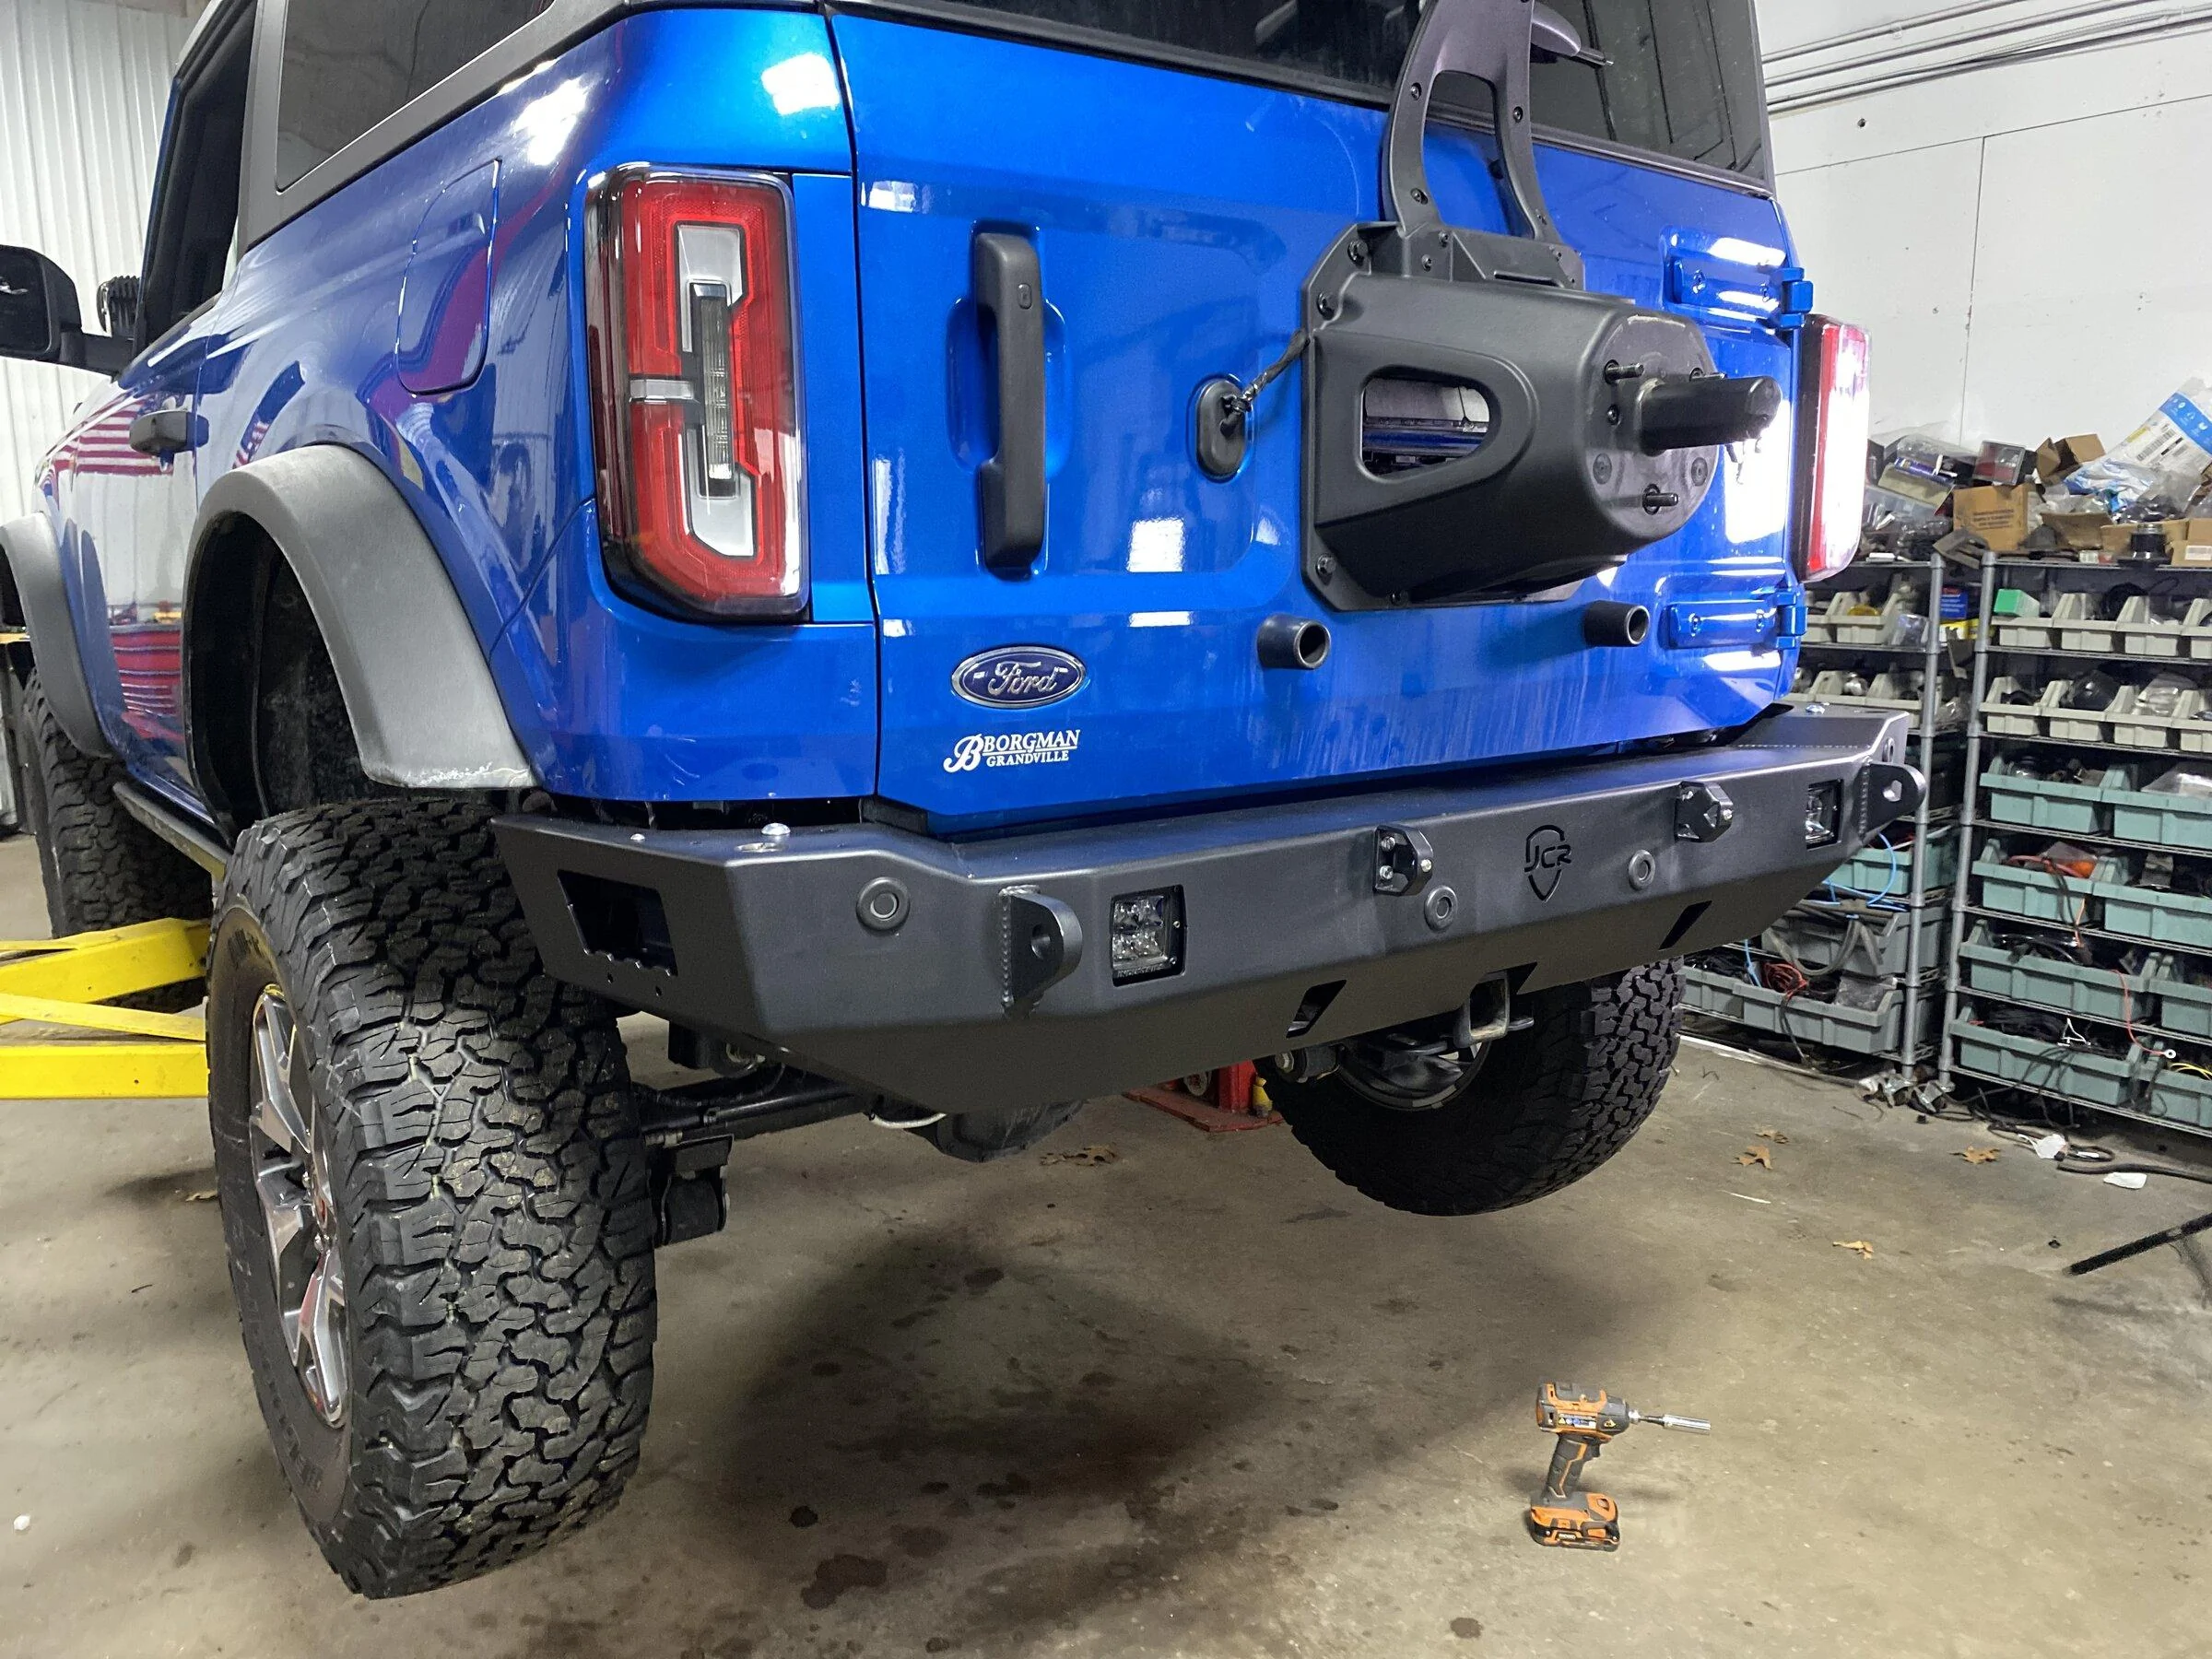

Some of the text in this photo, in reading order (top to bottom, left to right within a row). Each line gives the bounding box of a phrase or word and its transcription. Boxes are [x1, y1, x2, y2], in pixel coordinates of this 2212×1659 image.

[987, 661, 1058, 696] Ford
[983, 729, 1080, 752] BORGMAN
[986, 750, 1069, 767] GRANDVILLE
